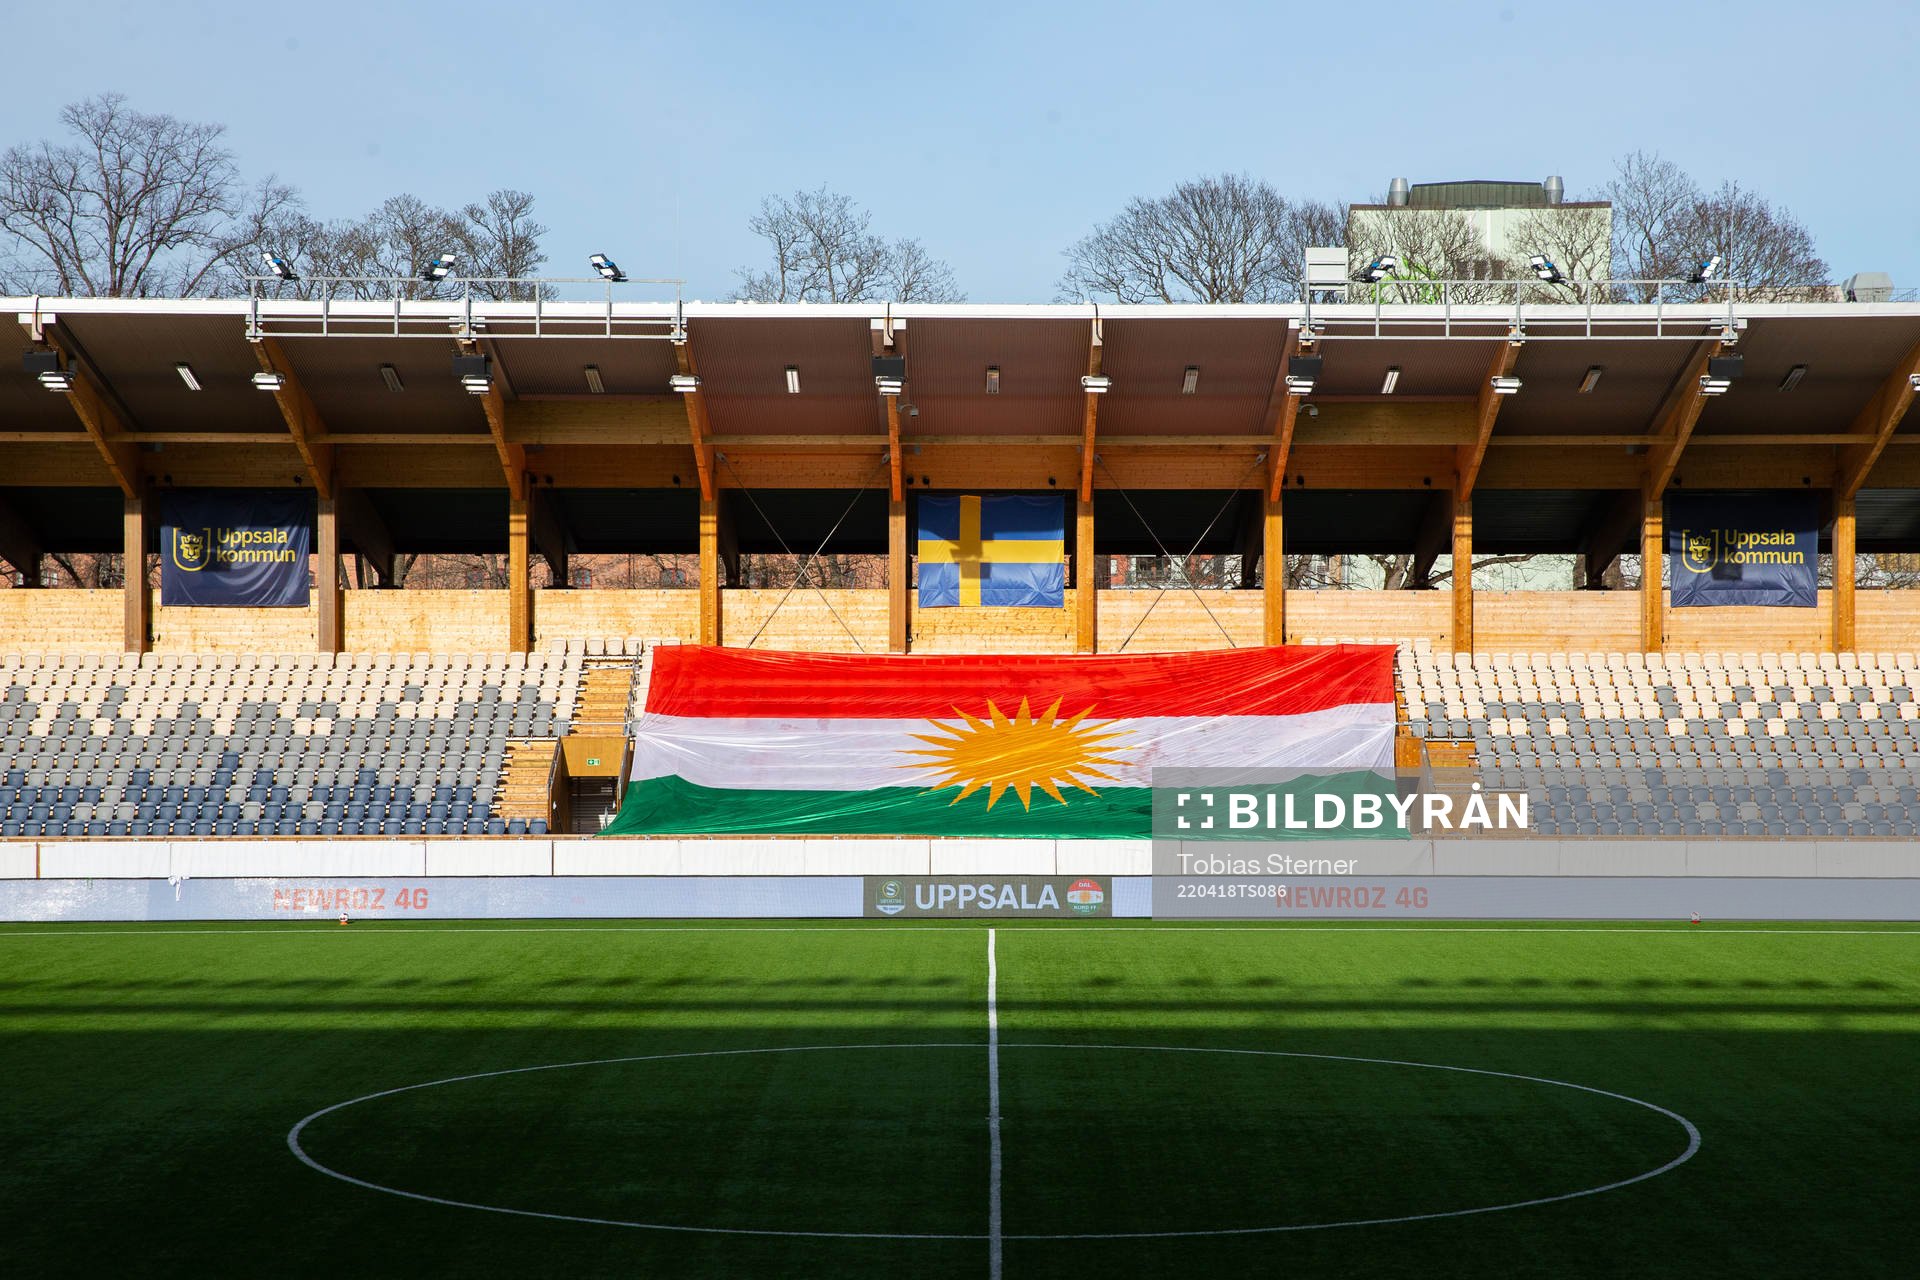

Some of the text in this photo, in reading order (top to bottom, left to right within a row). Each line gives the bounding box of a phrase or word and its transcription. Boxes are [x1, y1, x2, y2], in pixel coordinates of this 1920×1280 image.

[217, 527, 288, 547] Uppsala
[1724, 529, 1795, 549] Uppsala
[217, 545, 296, 562] kommun
[1724, 547, 1804, 564] kommun
[273, 887, 429, 910] NEWROZ 4G
[915, 884, 1060, 910] UPPSALA
[1276, 886, 1429, 909] NEWROZ 4G
